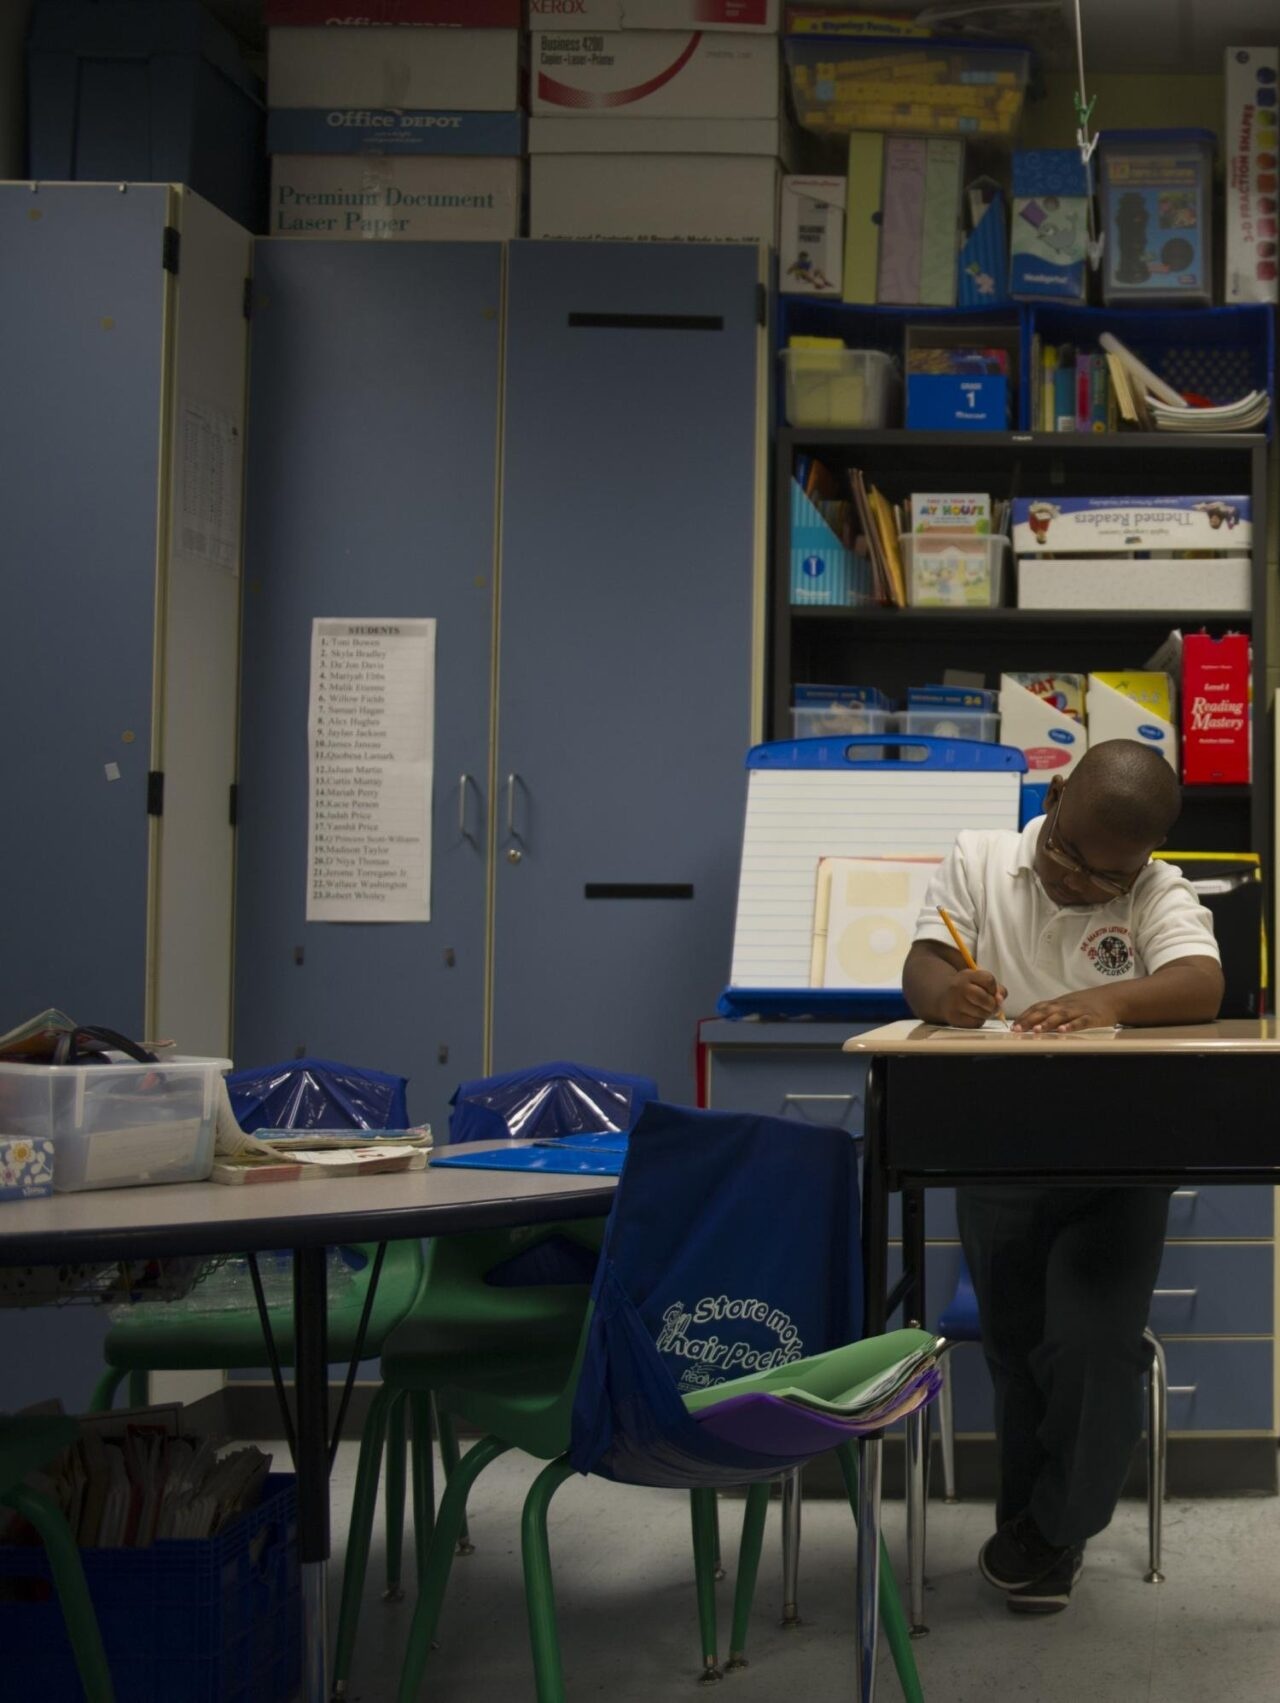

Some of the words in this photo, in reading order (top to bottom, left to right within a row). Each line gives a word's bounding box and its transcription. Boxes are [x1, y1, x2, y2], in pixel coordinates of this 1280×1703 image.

[530, 0, 587, 14] XEROX
[541, 36, 580, 51] Business
[326, 111, 394, 128] Office
[400, 115, 463, 128] DEPOT
[1239, 104, 1255, 153] SHAPES
[1239, 156, 1250, 219] FRACTION
[278, 185, 378, 206] Premium
[385, 187, 494, 209] Document
[277, 210, 336, 231] Laser
[344, 211, 409, 235] Paper
[965, 391, 975, 408] 1
[920, 505, 938, 515] MY
[942, 505, 984, 516] HOUSE
[1074, 513, 1130, 527] Readers
[1134, 512, 1193, 527] Themed
[348, 626, 401, 635] STUDENTS
[1191, 696, 1244, 716] Reading
[1190, 713, 1244, 731] Mastery
[1087, 927, 1108, 943] MARTIN
[1108, 926, 1128, 936] LUTHER
[1094, 960, 1133, 976] EXPLORERS
[693, 1295, 769, 1324] Store
[680, 1369, 715, 1388] Really
